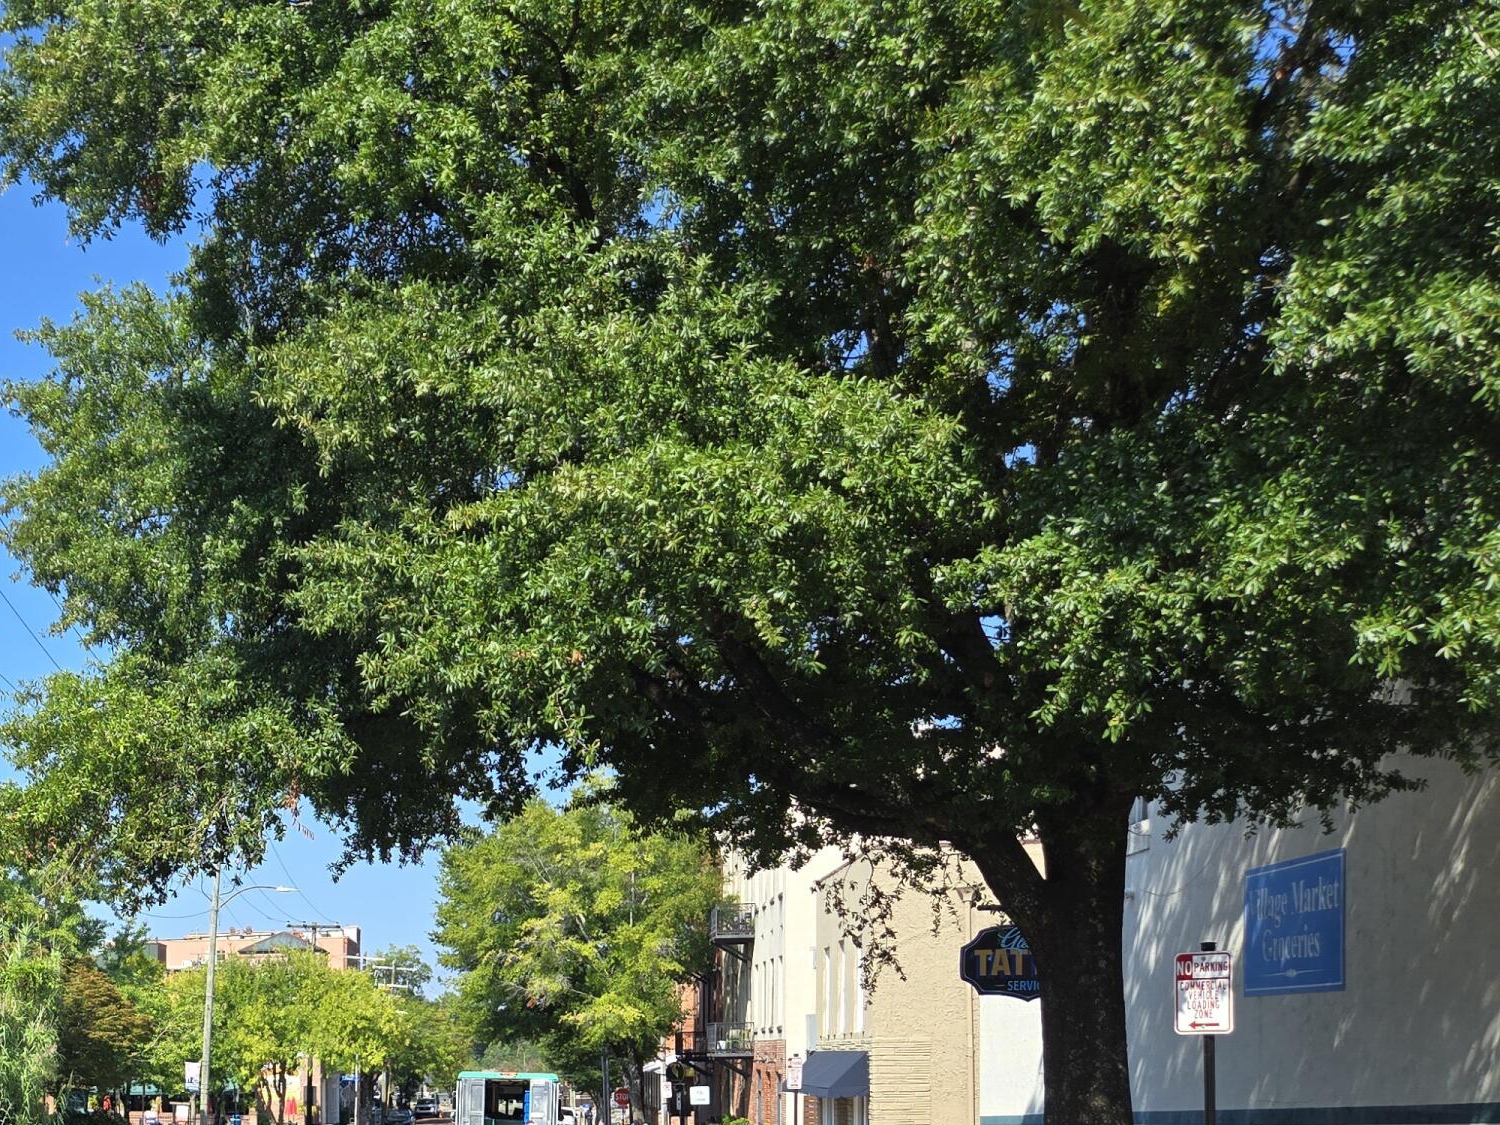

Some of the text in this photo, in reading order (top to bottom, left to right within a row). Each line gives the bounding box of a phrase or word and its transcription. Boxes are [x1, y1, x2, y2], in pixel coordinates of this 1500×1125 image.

[1291, 876, 1340, 915] Market
[1262, 924, 1320, 962] Groceries
[974, 948, 1032, 976] TAT
[1176, 960, 1228, 976] NO PARKING
[1180, 981, 1227, 991] COMMERCIAL
[1189, 991, 1219, 1000] VEHICLE
[1187, 1000, 1220, 1009] LOADING
[1194, 1009, 1213, 1019] ZONE
